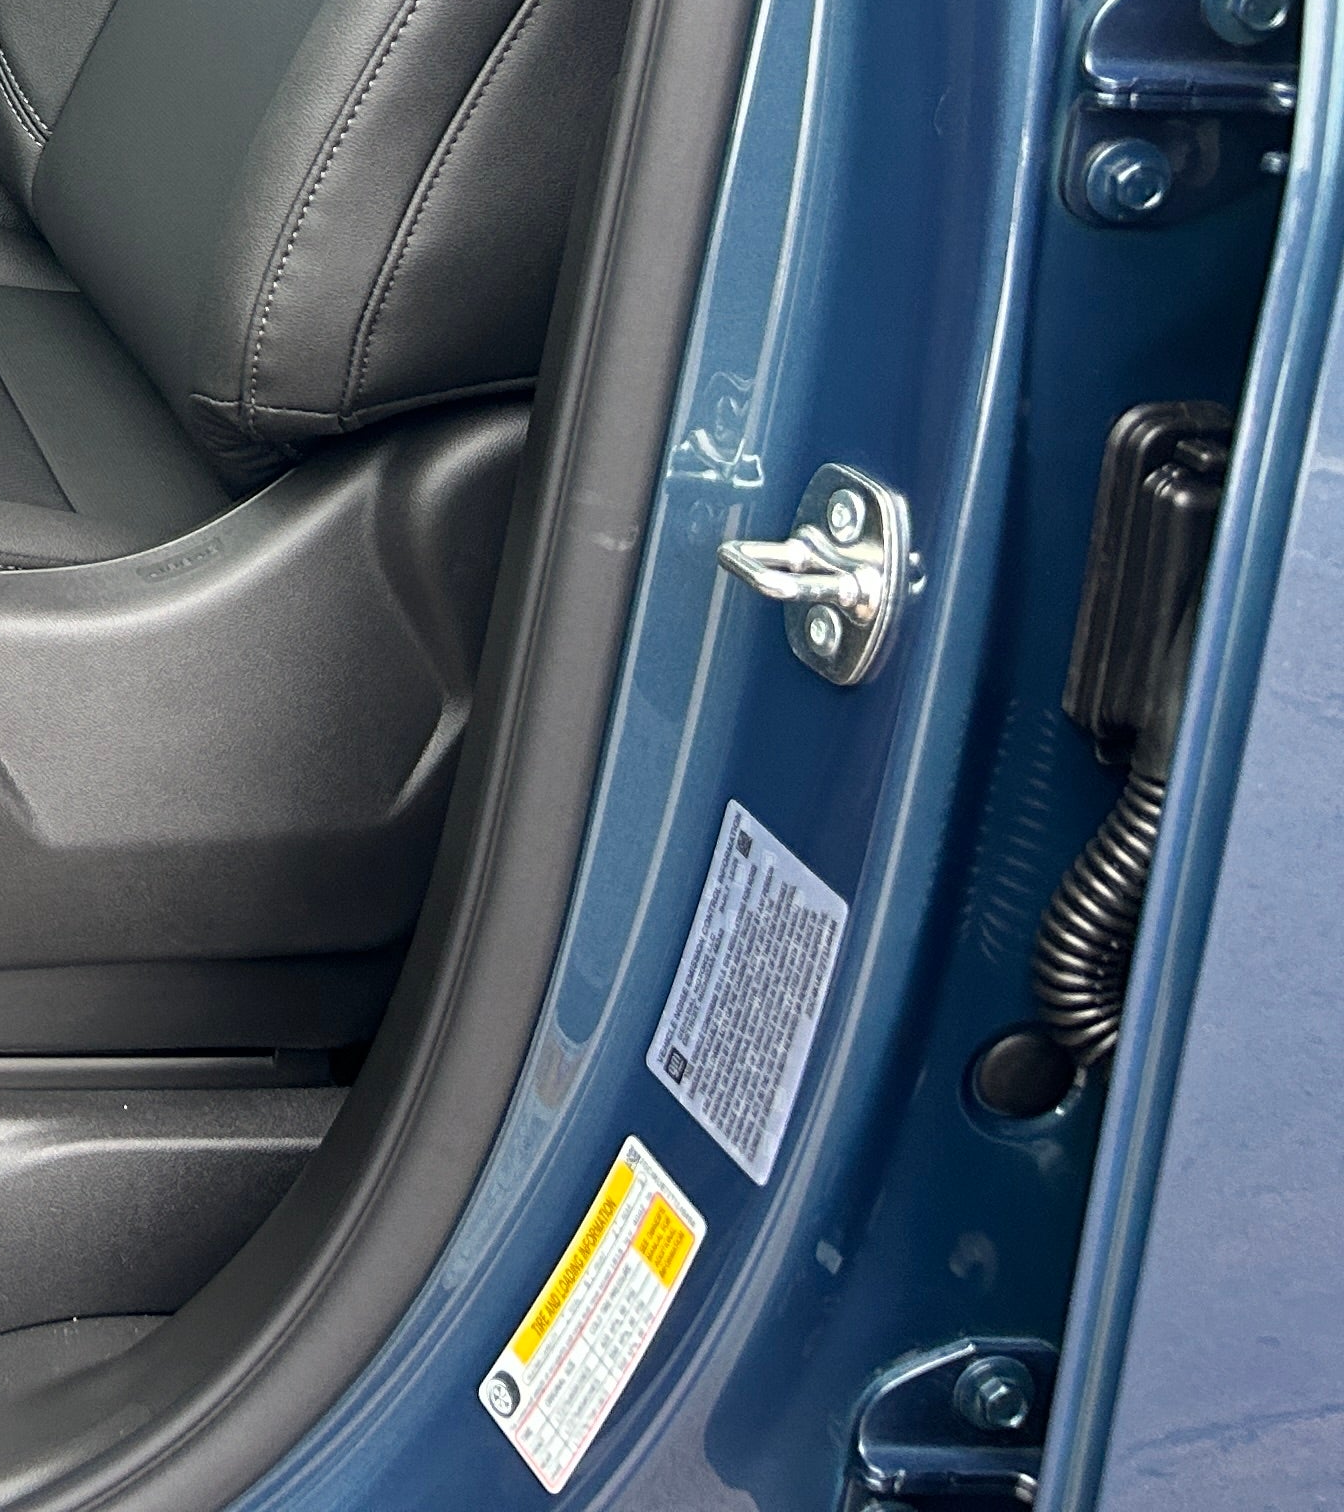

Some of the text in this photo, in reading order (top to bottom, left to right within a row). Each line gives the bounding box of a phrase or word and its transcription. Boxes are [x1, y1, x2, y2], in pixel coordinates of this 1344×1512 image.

[657, 1018, 676, 1066] VEHICLE
[674, 986, 688, 1020] NOISE
[685, 936, 704, 986] EMISSION
[701, 885, 720, 936] CONTROL
[716, 812, 742, 883] INFORMATION
[677, 995, 694, 1041] GENERAL
[693, 953, 708, 994] MOTORS
[530, 1309, 549, 1338] TIRE
[543, 1291, 561, 1317] AND
[554, 1252, 584, 1299] LOADING
[576, 1195, 617, 1260] INFORMATION
